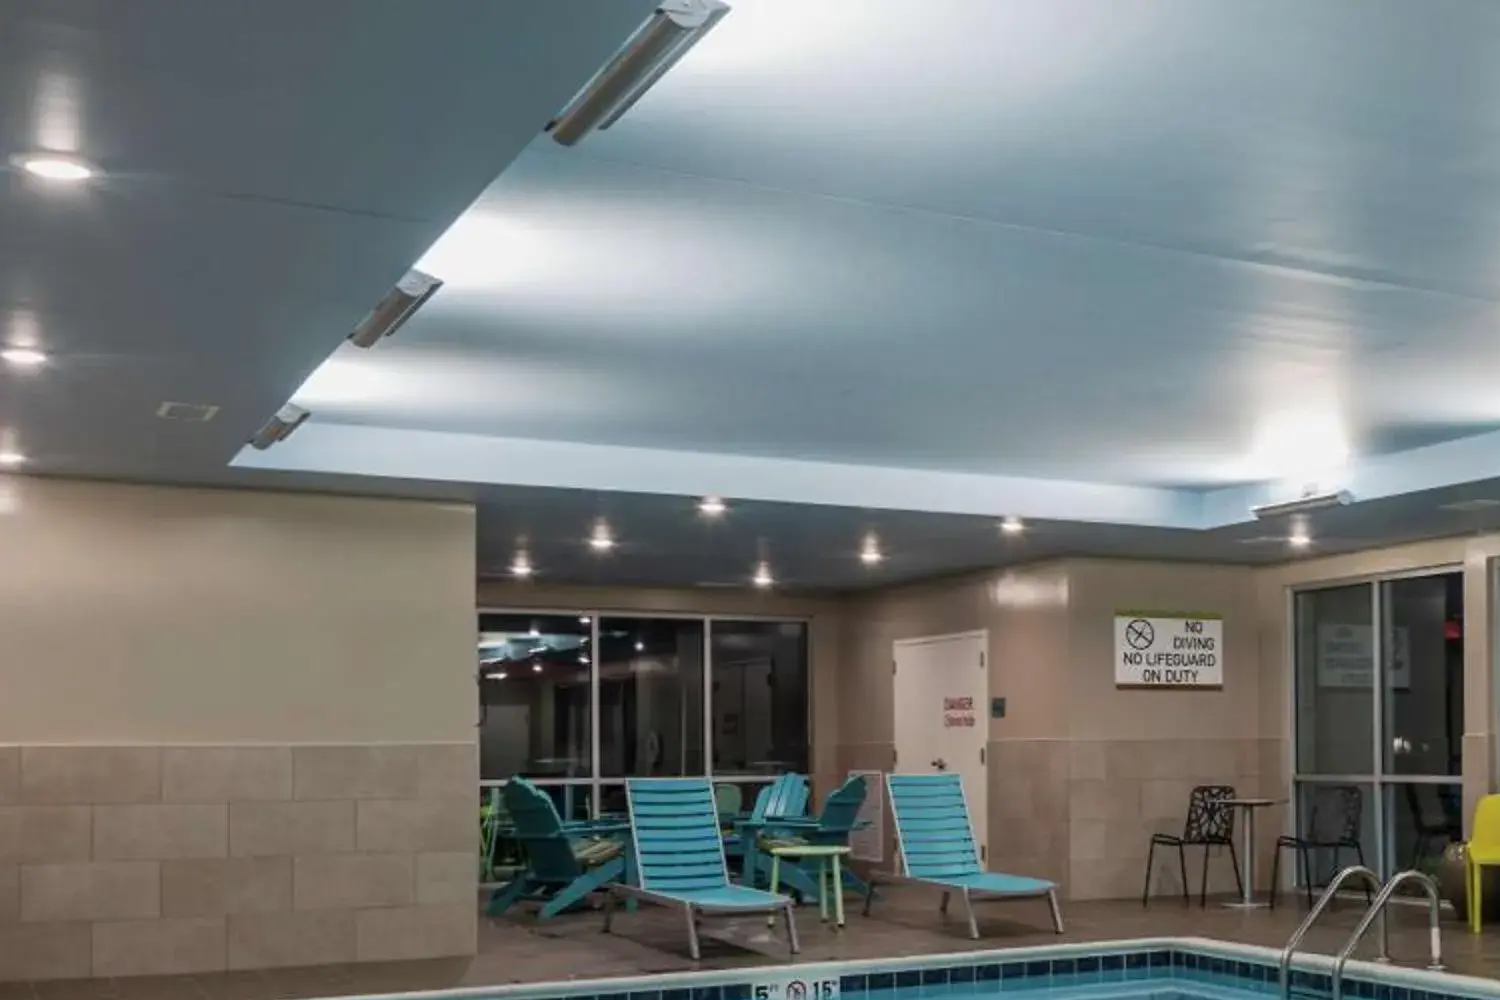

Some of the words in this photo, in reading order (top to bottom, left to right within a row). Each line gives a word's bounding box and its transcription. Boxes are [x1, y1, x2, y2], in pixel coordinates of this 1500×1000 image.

[1184, 621, 1203, 634] NO
[1173, 637, 1215, 650] DIVING
[1123, 652, 1143, 666] NO
[1145, 653, 1217, 667] LIFEGUARD
[1142, 669, 1161, 682] ON
[1165, 669, 1199, 683] DUTY
